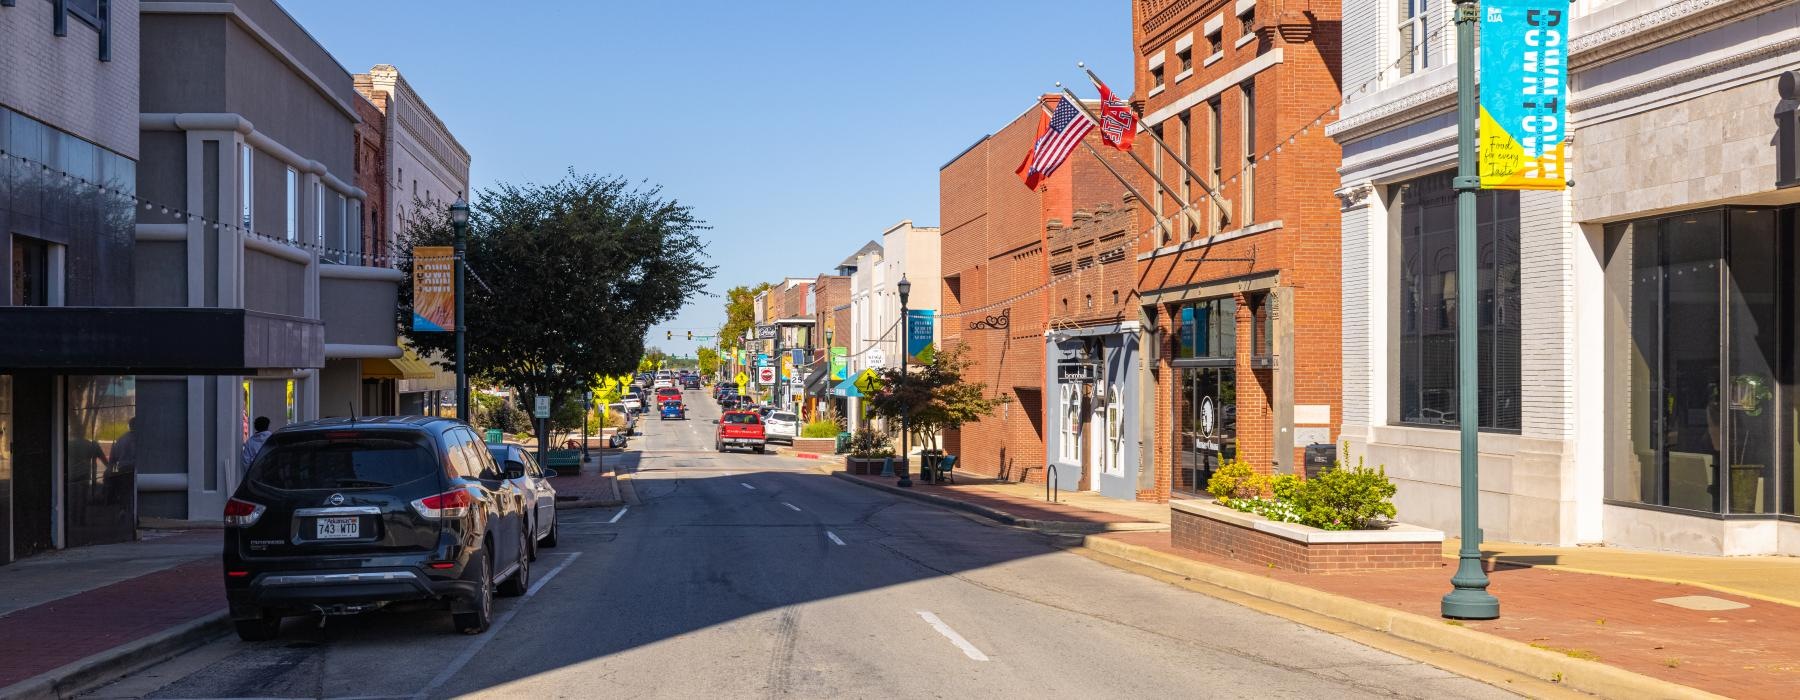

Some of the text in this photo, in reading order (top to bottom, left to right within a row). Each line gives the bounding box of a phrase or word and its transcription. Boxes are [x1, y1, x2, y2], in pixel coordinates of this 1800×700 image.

[1489, 135, 1513, 152] Food
[1498, 153, 1519, 168] every
[1489, 162, 1513, 177] Taste
[318, 523, 357, 535] 743 WTD
